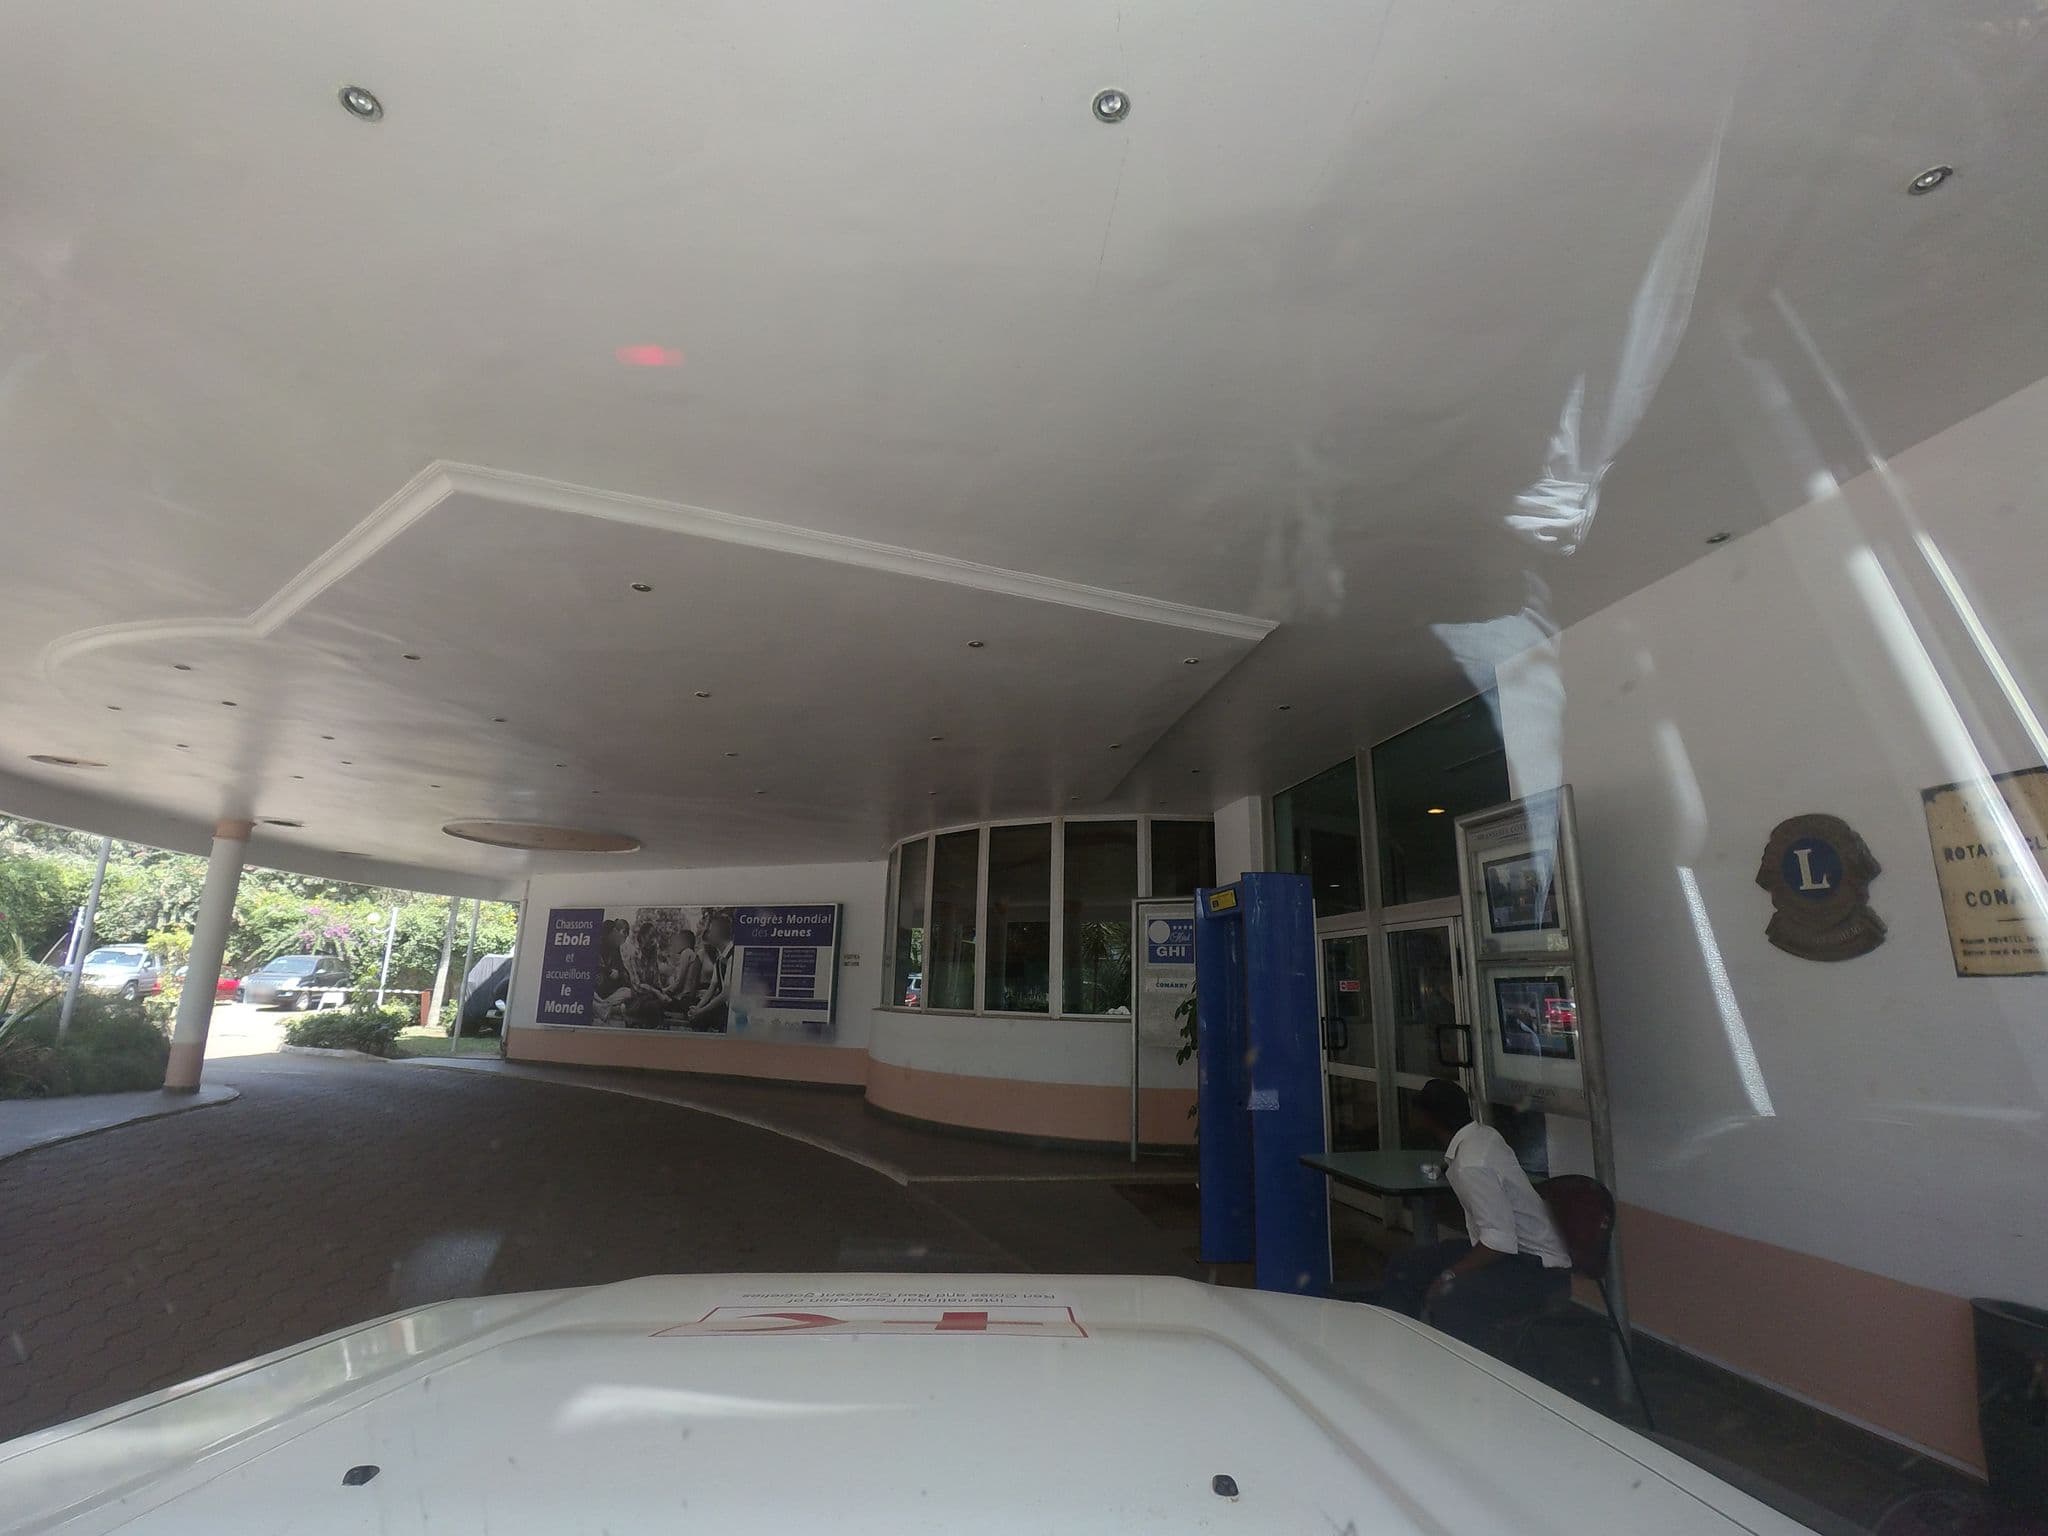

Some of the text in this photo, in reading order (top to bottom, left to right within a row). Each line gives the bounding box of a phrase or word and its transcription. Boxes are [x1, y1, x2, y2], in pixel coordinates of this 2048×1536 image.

[1943, 843, 2003, 863] ROTAR
[1793, 848, 1831, 891] L
[555, 919, 593, 930] Chassons
[739, 913, 832, 927] Congrès Mondial
[554, 932, 591, 946] Ebola
[752, 928, 812, 938] des Jeunes
[565, 953, 575, 963] et
[1156, 946, 1185, 957] GHI
[545, 968, 591, 980] accueillons
[560, 983, 572, 997] le
[544, 1000, 585, 1014] Monde
